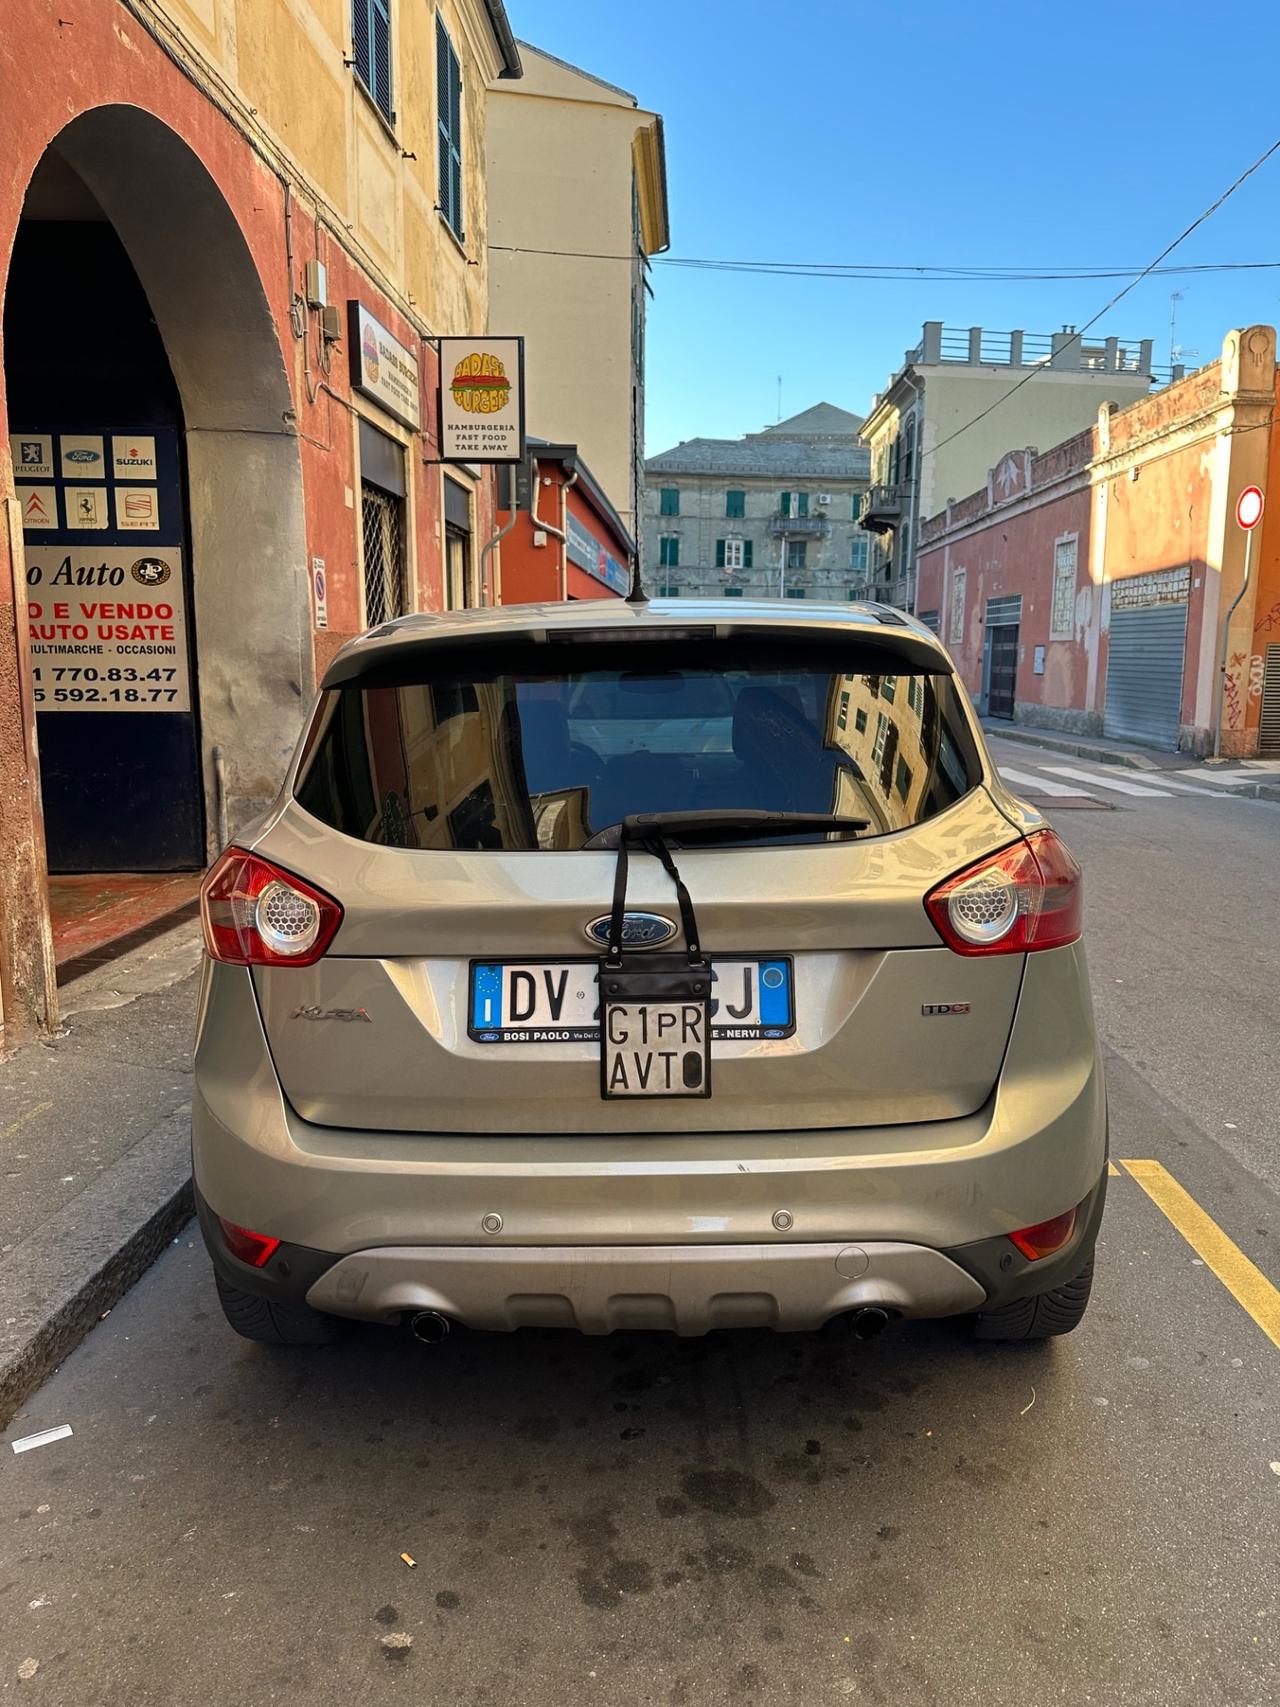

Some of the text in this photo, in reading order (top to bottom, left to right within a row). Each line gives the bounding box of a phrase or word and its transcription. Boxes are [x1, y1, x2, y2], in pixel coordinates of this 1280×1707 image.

[70, 452, 94, 461] Ford
[116, 458, 153, 466] SUZUKI
[50, 555, 125, 587] Auto
[54, 603, 70, 619] E
[79, 603, 174, 619] VENDO
[30, 625, 175, 640] AUTO USATE
[31, 645, 104, 654] ULTIMARCHE
[116, 645, 176, 654] OCCASIONI
[52, 668, 177, 681] 770.83.47
[54, 689, 178, 702] 592.18.77
[510, 970, 569, 1021] DV
[504, 1032, 529, 1041] BOSI
[533, 1031, 570, 1040] PAOLO
[726, 1029, 760, 1038] NERVI
